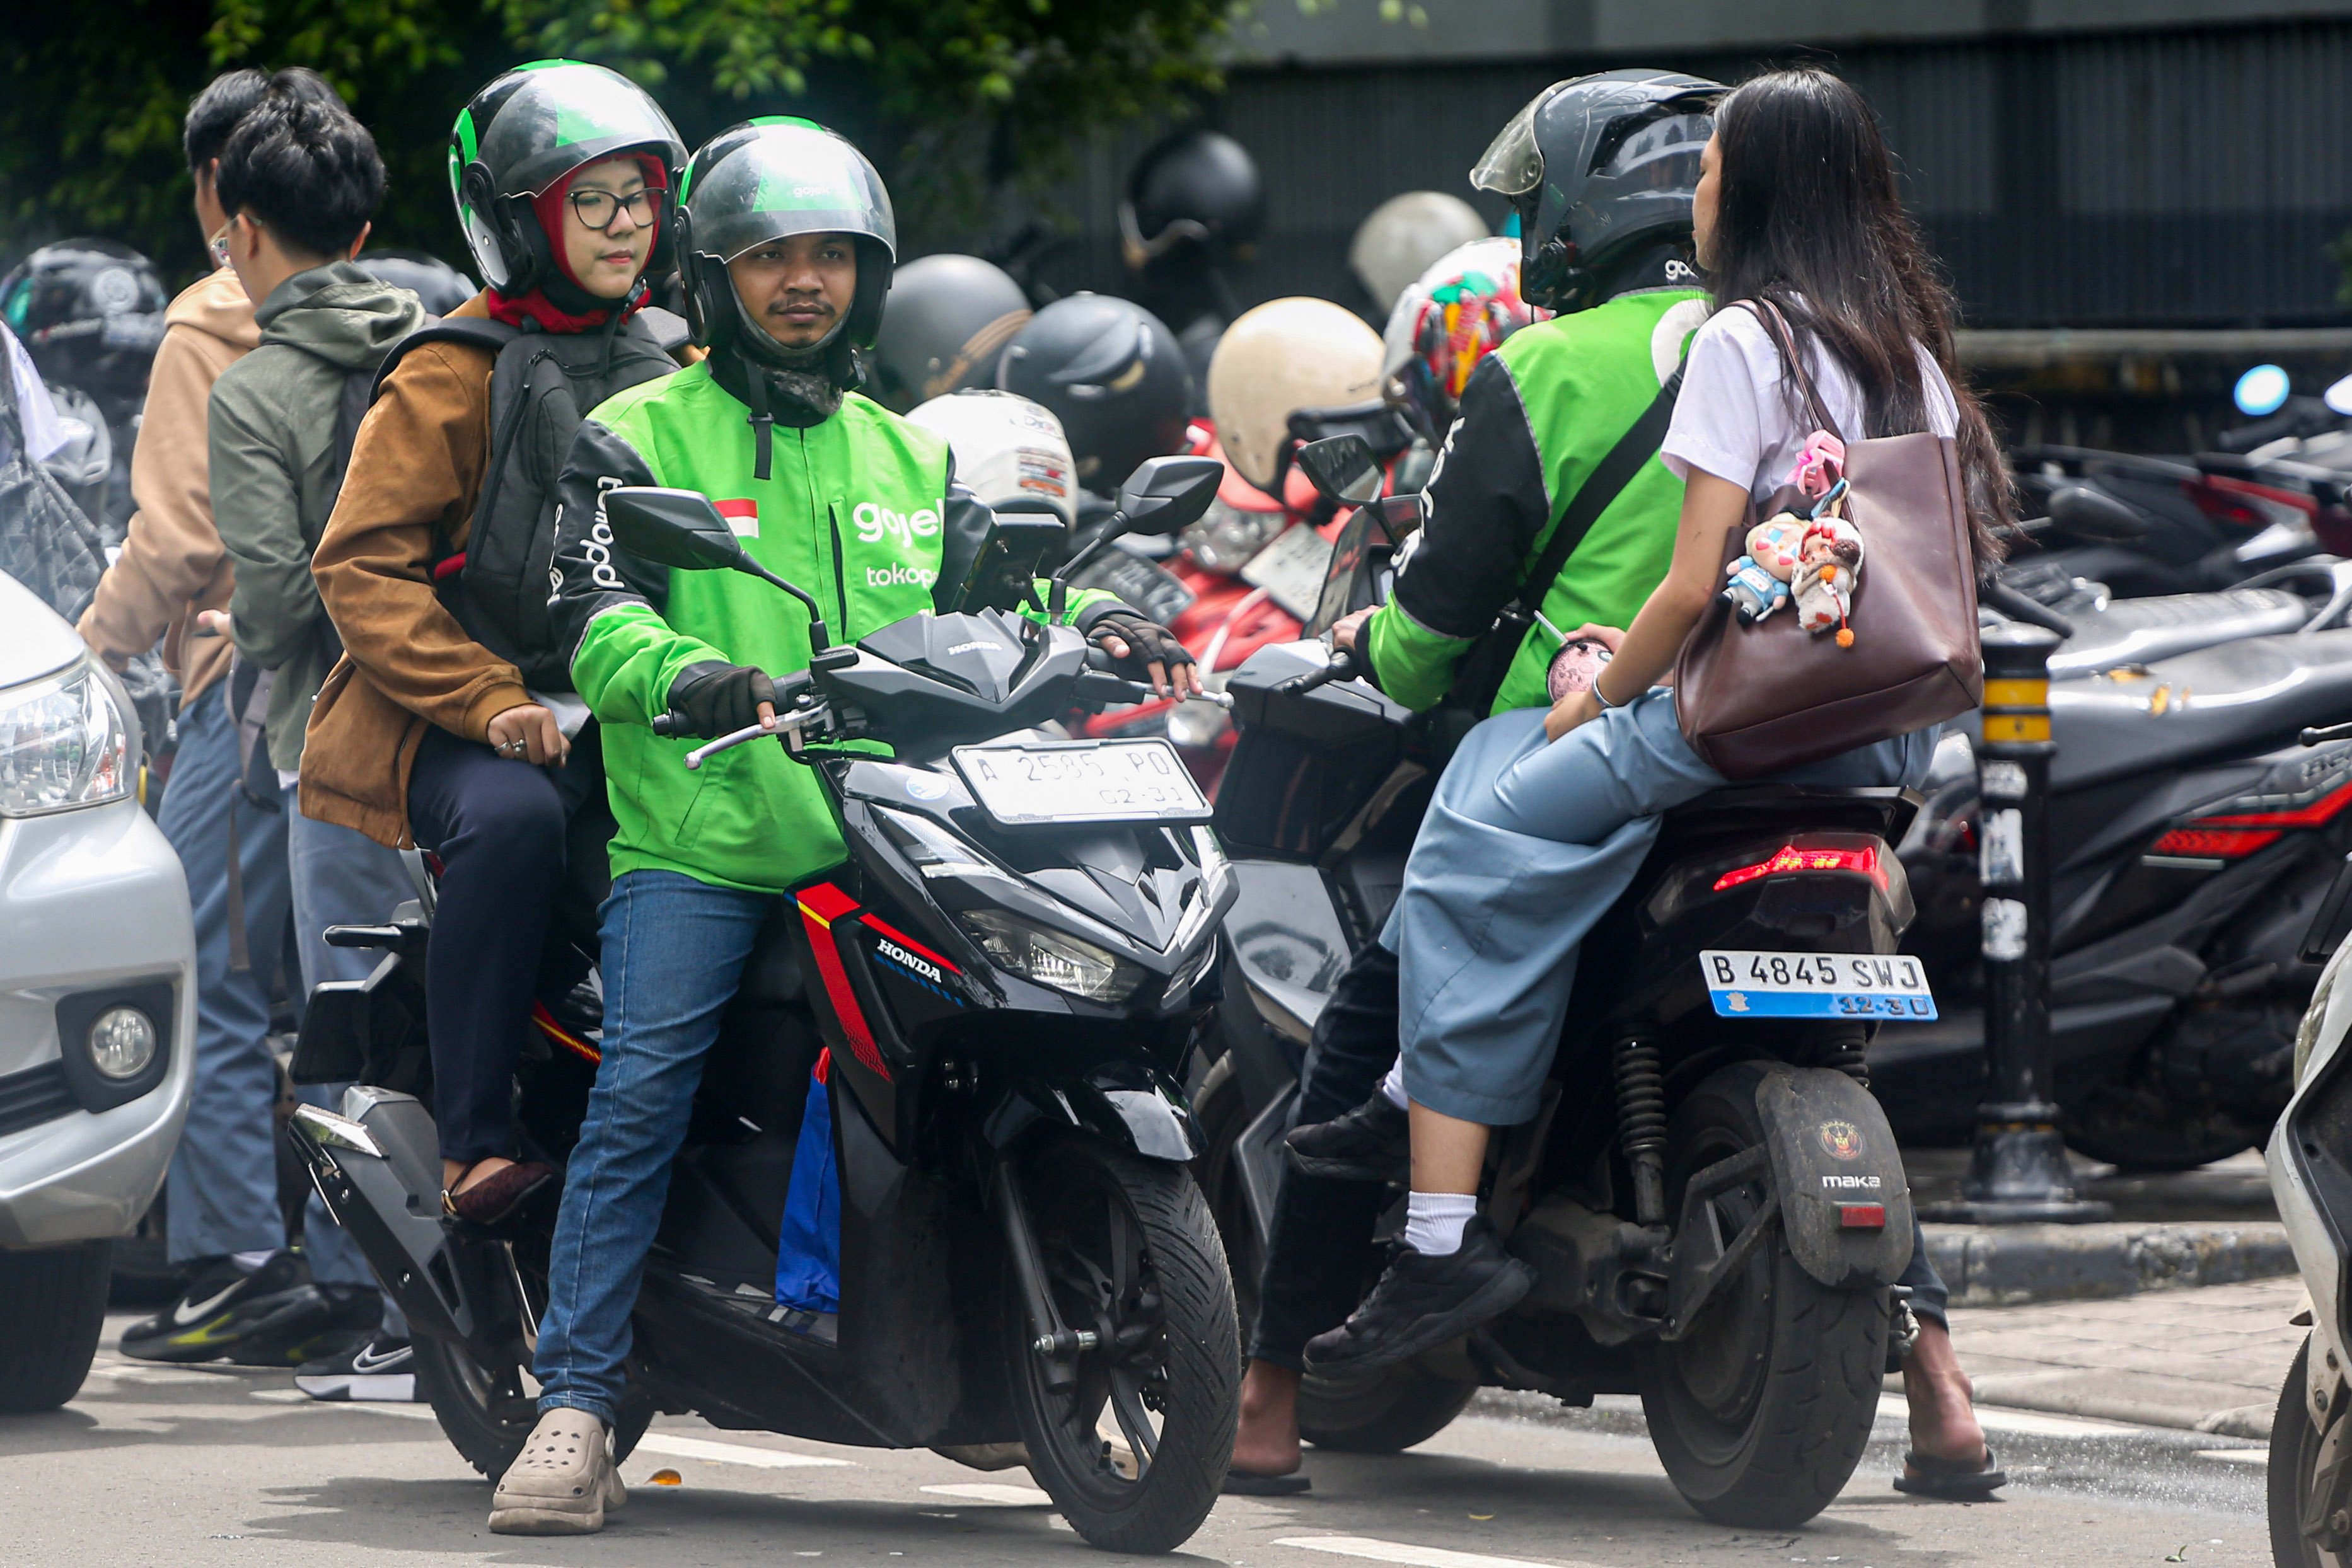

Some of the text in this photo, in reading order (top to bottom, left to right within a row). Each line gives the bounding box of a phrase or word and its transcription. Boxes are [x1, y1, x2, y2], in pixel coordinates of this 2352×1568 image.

[877, 938, 942, 983] HONDA
[1712, 955, 1920, 989] B 4845 SWJ
[1821, 1175, 1882, 1189] maka
